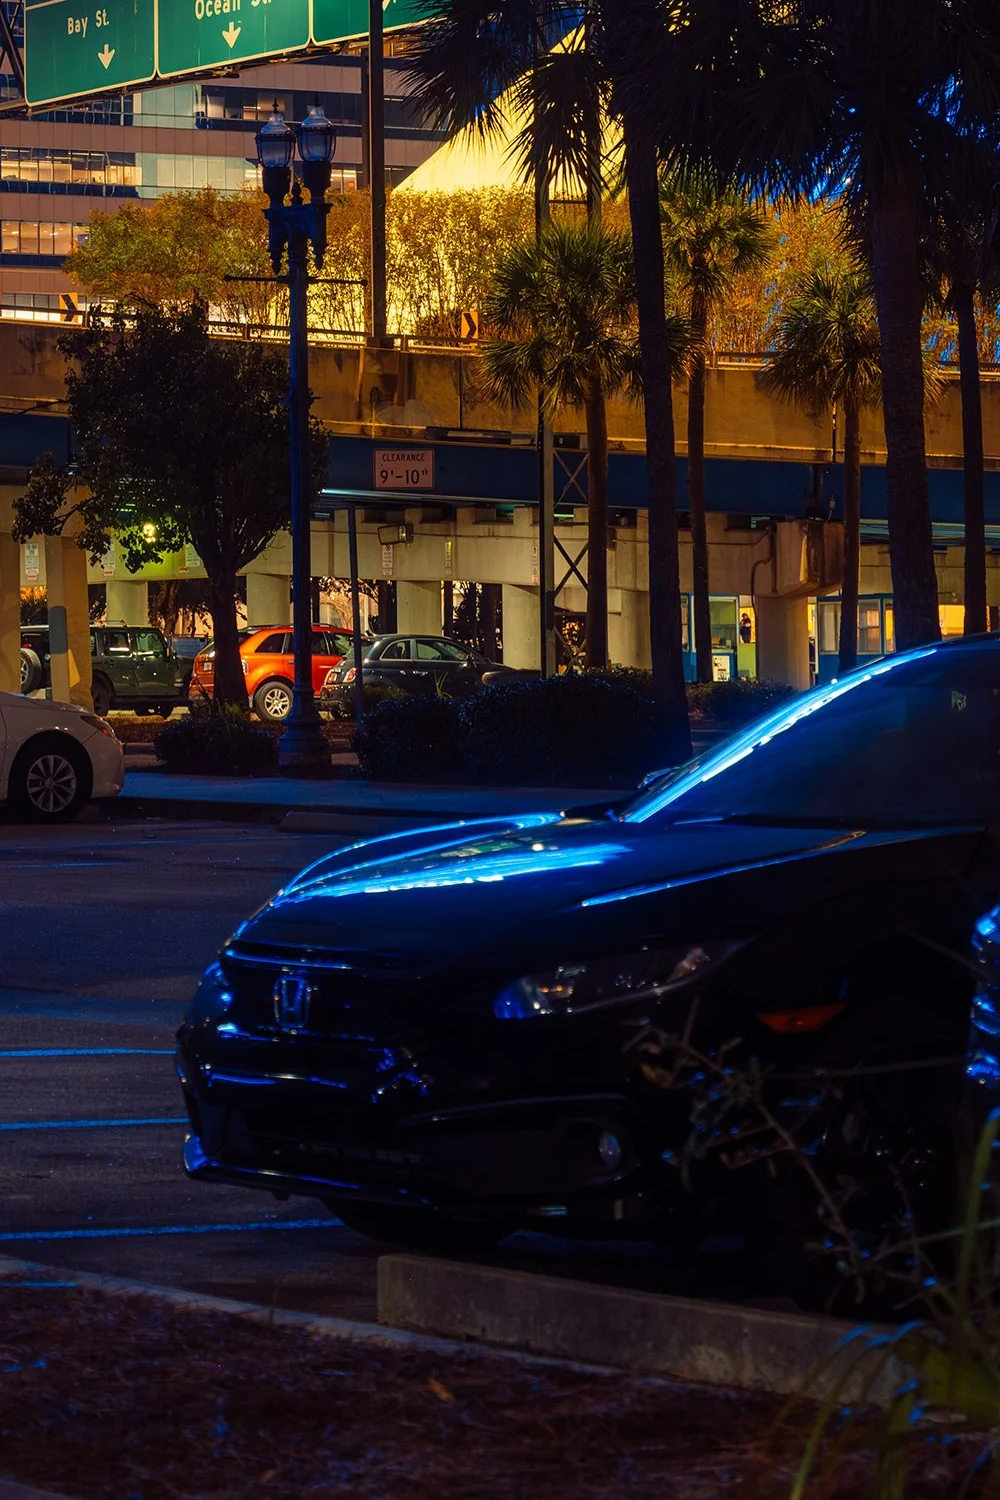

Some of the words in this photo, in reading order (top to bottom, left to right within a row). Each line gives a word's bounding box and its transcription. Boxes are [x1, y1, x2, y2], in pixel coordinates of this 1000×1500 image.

[67, 16, 88, 38] Bay
[95, 8, 110, 28] St.
[382, 453, 425, 462] CLEARANCE
[380, 468, 428, 484] 9'-10"
